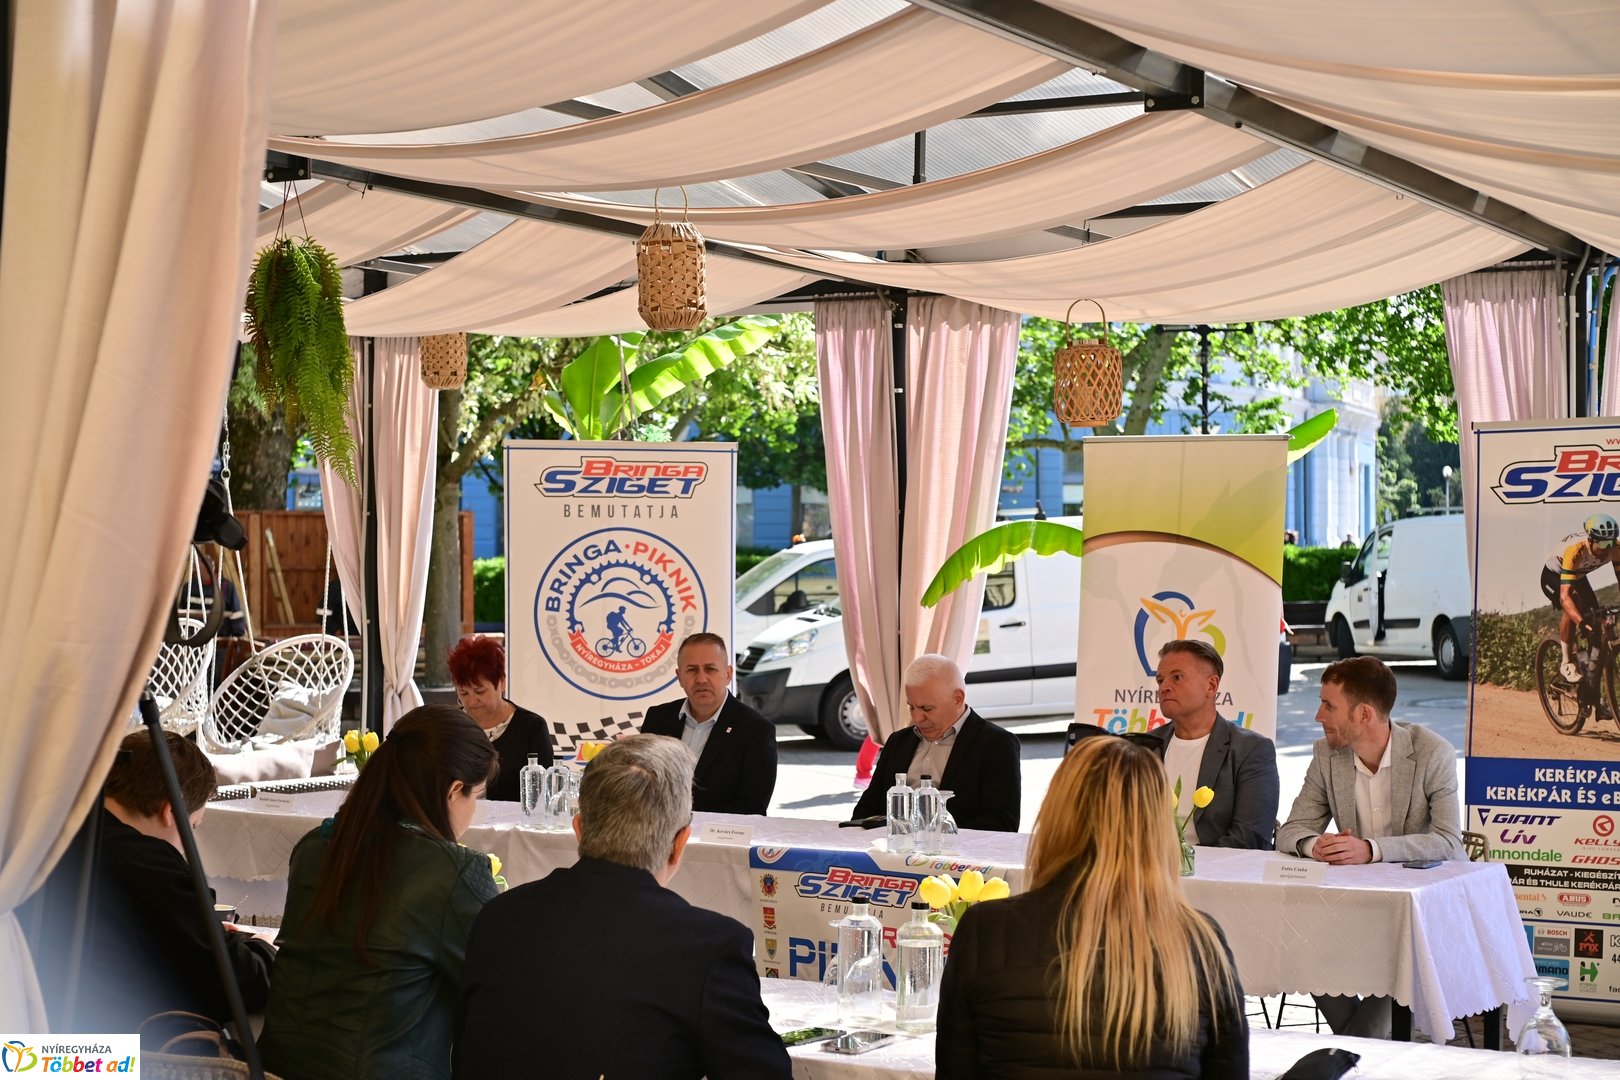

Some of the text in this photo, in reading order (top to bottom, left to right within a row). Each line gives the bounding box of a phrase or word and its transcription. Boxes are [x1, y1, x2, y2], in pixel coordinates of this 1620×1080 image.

[582, 460, 704, 478] BRINGA
[543, 470, 701, 495] SZIGET
[563, 504, 678, 519] BEMUTATJA
[545, 539, 697, 612] BRINGA PIKNIK
[575, 645, 633, 671] NYÍREGYHÁZA
[641, 645, 667, 666] TOKAJ
[1535, 766, 1620, 785] KERÉKPÁR
[1486, 784, 1572, 803] KERÉKPÁR
[1577, 787, 1597, 804] ÉS
[1492, 813, 1562, 826] GIANT
[827, 868, 917, 891] BRINGA
[1523, 867, 1569, 877] RUHÁZAT
[799, 875, 913, 905] SZIGET
[1526, 877, 1538, 886] ÉS
[1540, 879, 1570, 888] THULE
[1562, 895, 1587, 903] ABUS
